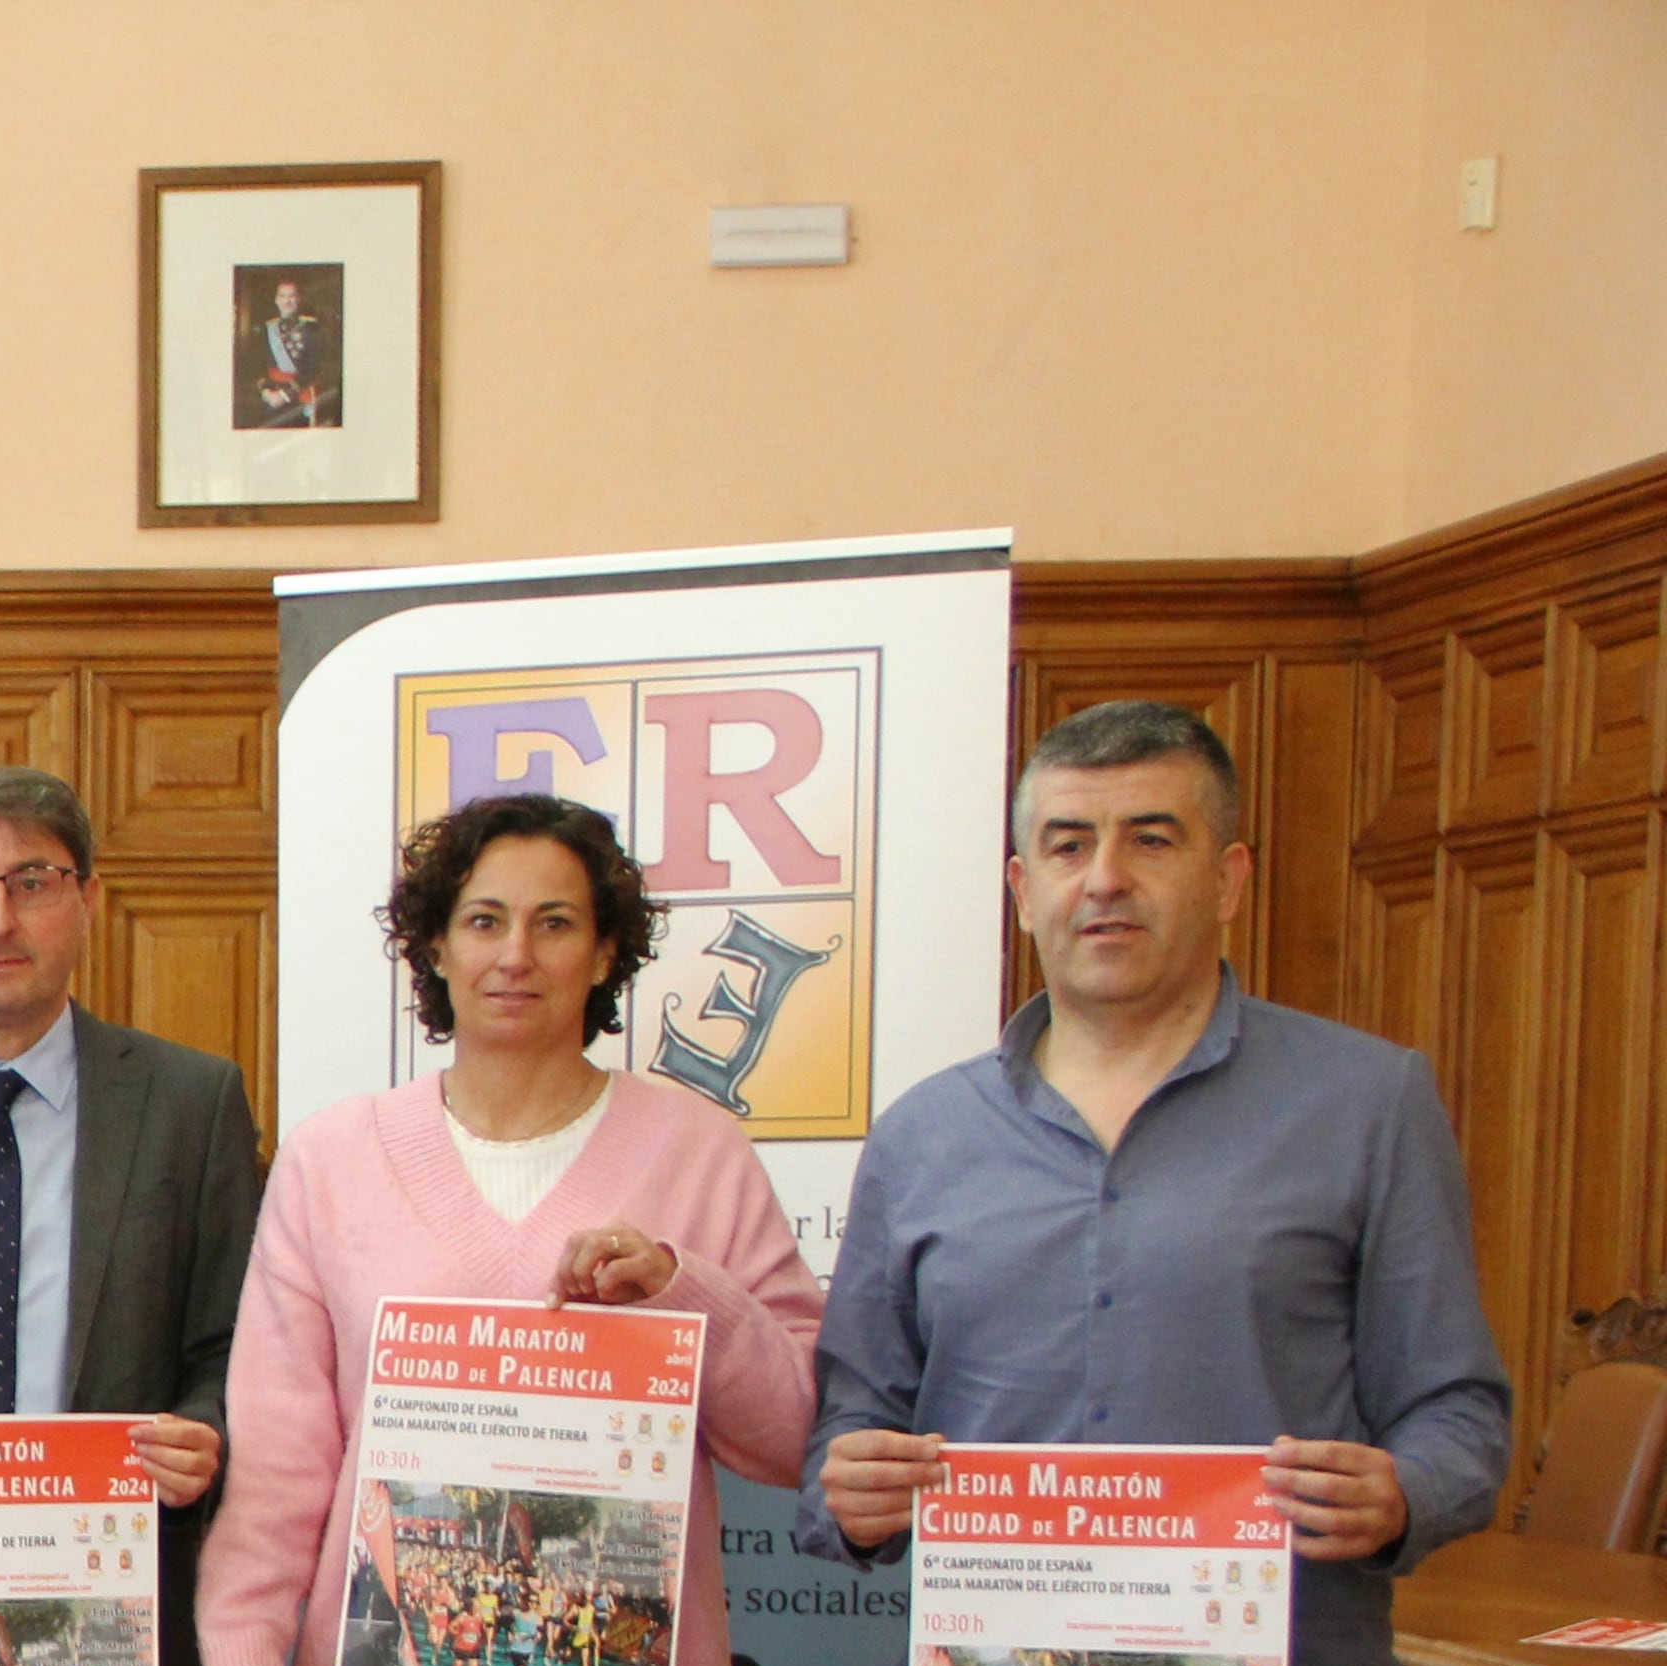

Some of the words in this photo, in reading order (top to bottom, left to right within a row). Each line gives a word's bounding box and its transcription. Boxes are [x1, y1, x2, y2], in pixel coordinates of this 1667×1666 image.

[641, 687, 843, 892] R
[379, 1312, 456, 1345] MEDIA
[469, 1316, 585, 1352] MARATÓN
[672, 1328, 694, 1346] 14
[665, 1353, 692, 1365] abril
[375, 1349, 458, 1381] CIUDAD
[469, 1368, 487, 1382] DE
[499, 1356, 613, 1391] PALENCIA
[647, 1376, 690, 1397] 2024
[390, 1398, 459, 1413] CAMPEONATO
[461, 1403, 474, 1414] DE
[477, 1404, 518, 1417] ESPAÑA
[373, 1416, 404, 1428] MEDIA
[407, 1418, 456, 1432] MARATÓN
[459, 1422, 478, 1434] DEL
[481, 1423, 530, 1437] EJÉRCITO
[532, 1427, 545, 1439] DE
[548, 1428, 587, 1442] TIERRA
[368, 1448, 407, 1468] 10:30
[411, 1451, 421, 1469] h
[108, 1479, 147, 1496] 2024
[1029, 1463, 1160, 1499] MARATÓN
[922, 1503, 1019, 1535] CIUDAD
[1033, 1520, 1052, 1536] DE
[1067, 1506, 1194, 1539] PALENCIA
[2, 1536, 14, 1547] DE
[18, 1536, 55, 1547] TIERRA
[1234, 1523, 1279, 1543] 2024
[943, 1557, 1023, 1570] CAMPEONATO
[1027, 1559, 1041, 1571] DE
[1046, 1559, 1092, 1572] ESPAÑA
[925, 1577, 960, 1589] MEDIA
[965, 1577, 1022, 1590] MARATÓN
[1027, 1579, 1047, 1591] DEL
[1052, 1579, 1107, 1593] EJÉRCITO
[1110, 1582, 1124, 1593] DE
[1128, 1582, 1171, 1595] TIERRA
[745, 1579, 907, 1617] sociales
[923, 1613, 967, 1632] 10:30
[974, 1614, 984, 1632] h
